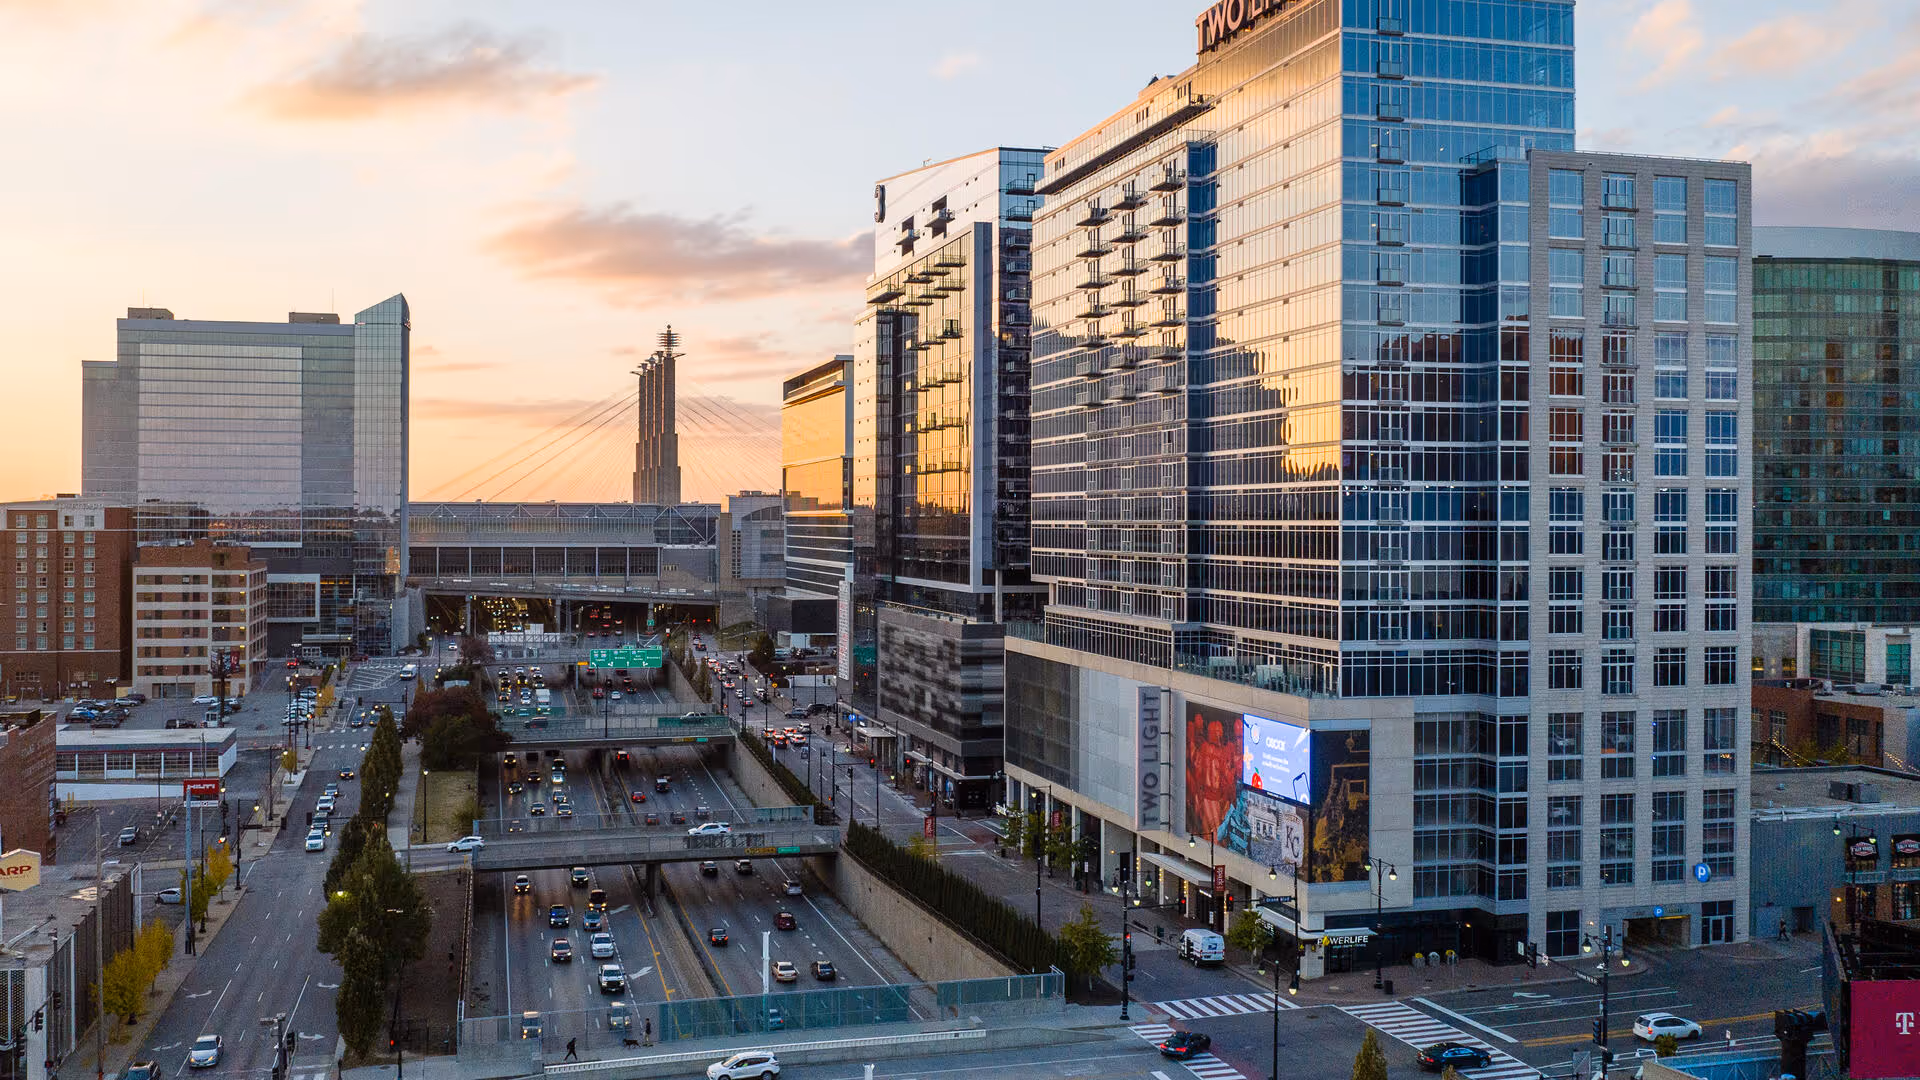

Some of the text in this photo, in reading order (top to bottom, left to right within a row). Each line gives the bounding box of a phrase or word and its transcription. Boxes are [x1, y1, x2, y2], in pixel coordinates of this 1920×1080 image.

[1195, 0, 1244, 52] TWO
[1142, 692, 1159, 826] TWO LIGHT
[1285, 825, 1300, 858] KC
[1698, 866, 1706, 878] P
